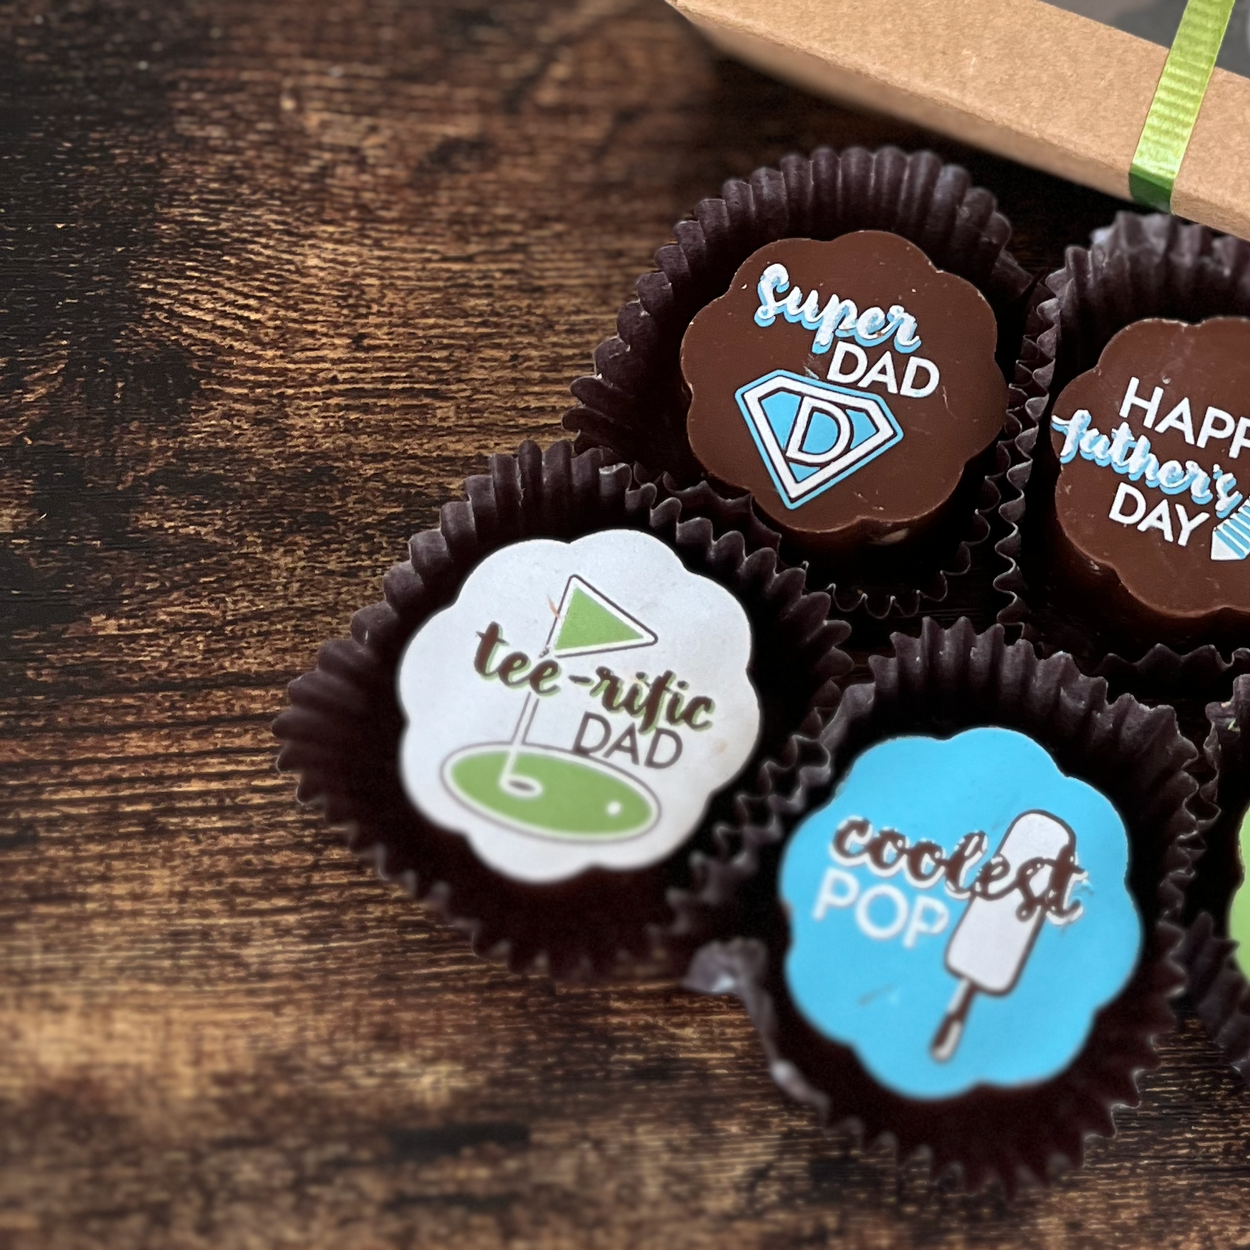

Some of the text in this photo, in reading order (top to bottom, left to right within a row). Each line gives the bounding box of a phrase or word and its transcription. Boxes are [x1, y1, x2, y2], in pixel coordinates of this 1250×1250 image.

[826, 342, 941, 398] DAD
[1051, 408, 1243, 518] father's
[1109, 481, 1210, 547] DAY
[473, 621, 717, 737] tee-rific
[571, 710, 684, 771] DAD
[812, 865, 950, 950] POP
[827, 814, 1085, 928] coolest
